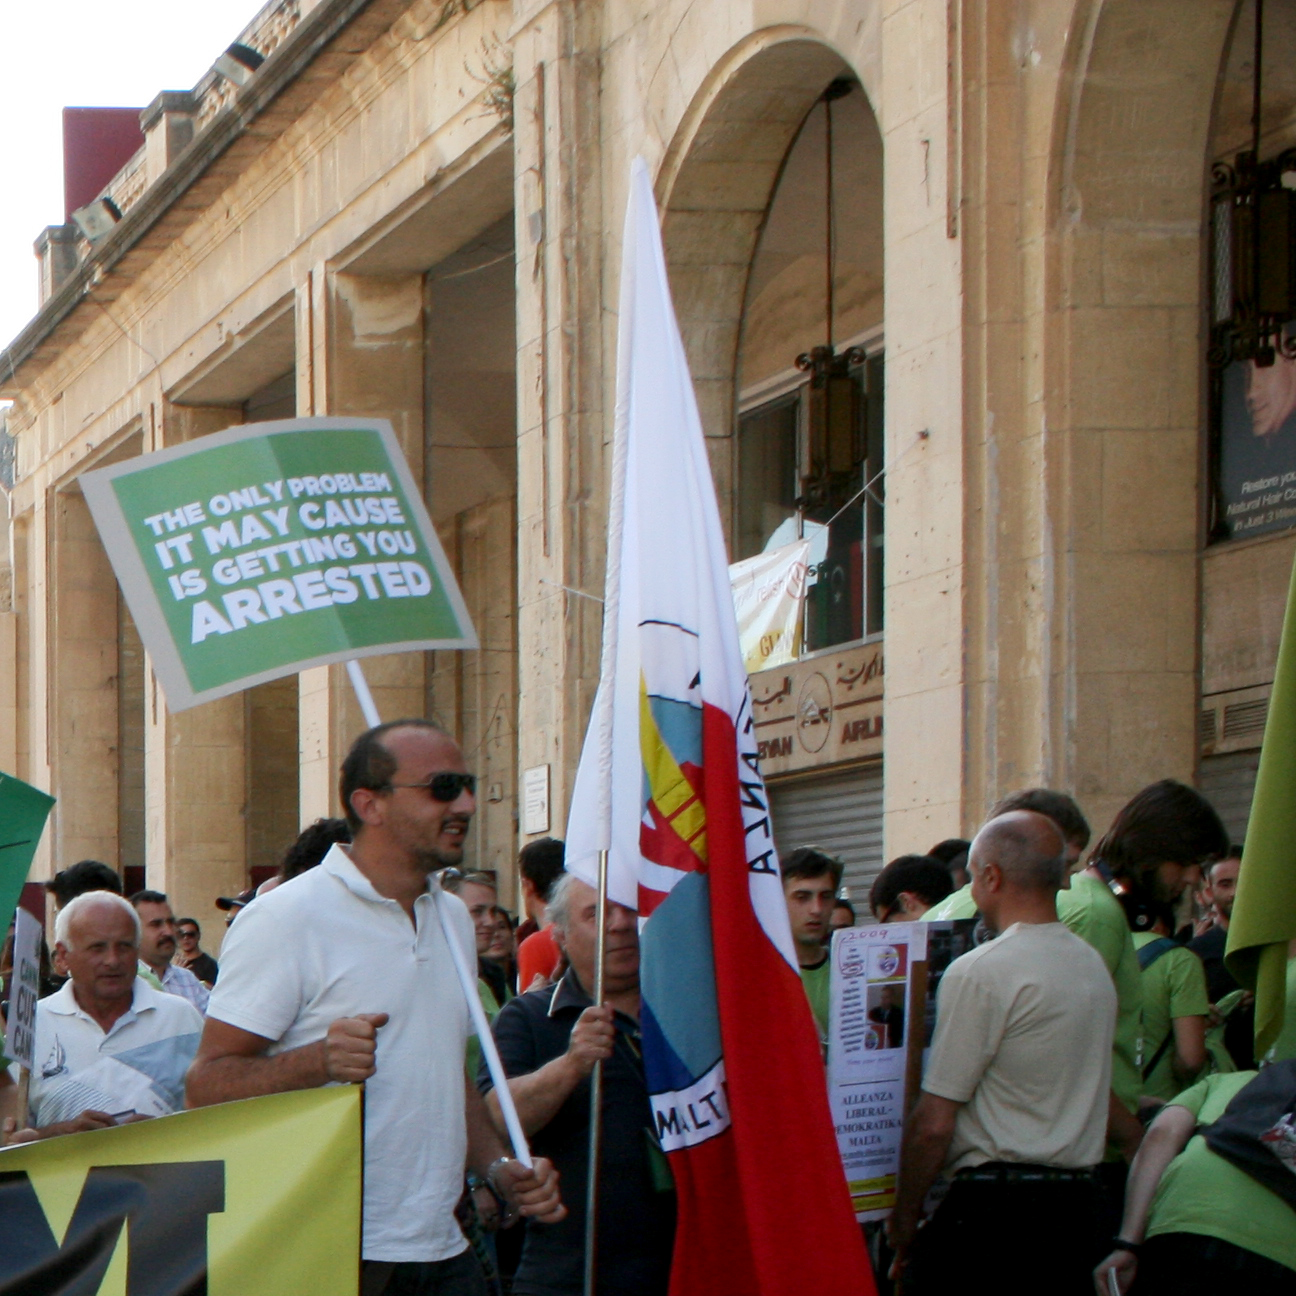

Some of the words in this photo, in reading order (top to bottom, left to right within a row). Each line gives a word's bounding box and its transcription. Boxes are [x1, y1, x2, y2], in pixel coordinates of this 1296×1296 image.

[144, 502, 205, 536] THE
[208, 480, 283, 516] ONLY
[287, 473, 392, 498] PROBLEM
[154, 533, 193, 570] IT
[201, 506, 289, 555] MAY
[299, 497, 405, 531] CAUSE
[167, 568, 206, 601] IS
[212, 534, 357, 584] GETTING
[355, 531, 416, 556] YOU
[191, 561, 432, 644] ARRESTED
[842, 1090, 894, 1106] ALLEANZA
[848, 1134, 882, 1148] MALTA
